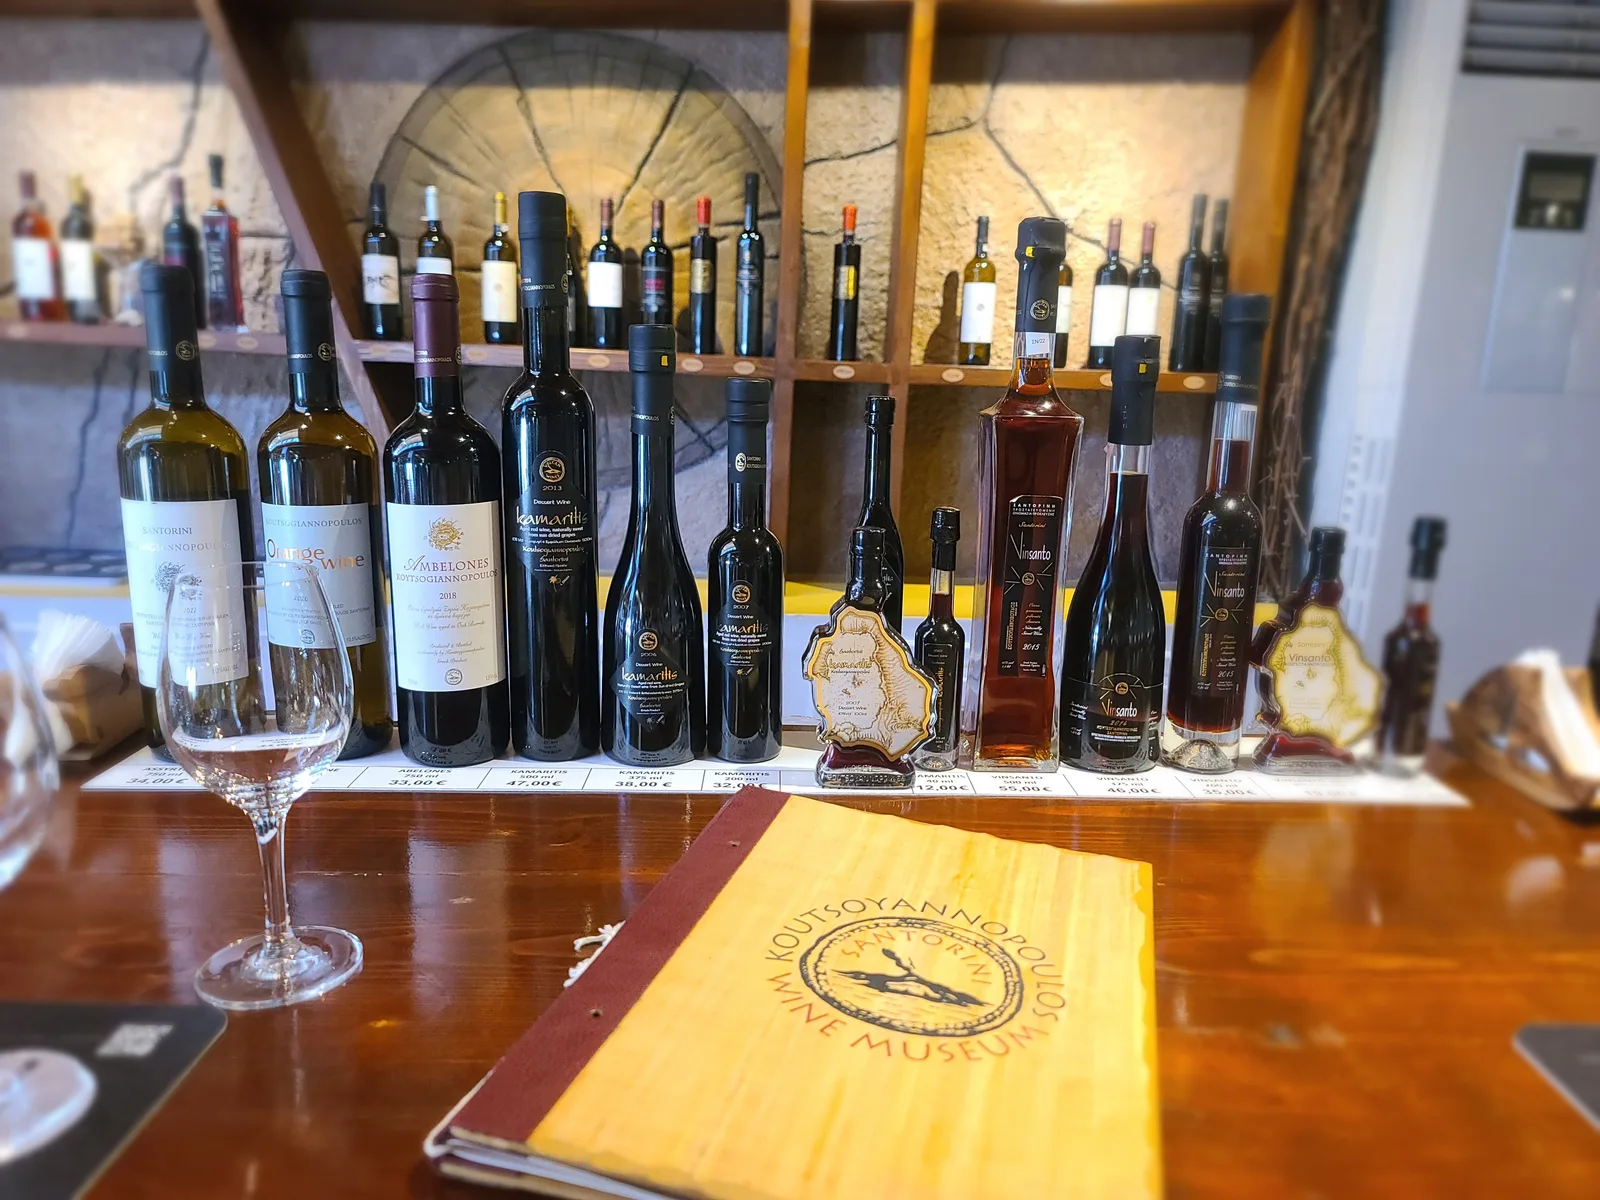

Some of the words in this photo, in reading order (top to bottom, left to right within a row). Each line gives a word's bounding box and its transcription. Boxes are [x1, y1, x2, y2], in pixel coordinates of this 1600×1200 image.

[516, 506, 588, 525] kamaritis
[142, 527, 193, 535] SANTORINI
[267, 538, 325, 565] Orange
[320, 555, 365, 570] wine
[1010, 531, 1051, 561] Vinsanto
[404, 555, 489, 572] AMBELONES
[1204, 571, 1245, 598] Vinsanto
[439, 592, 457, 600] 2018
[1022, 643, 1040, 651] 2015
[1289, 653, 1331, 662] Vinsanto
[621, 666, 678, 681] kamaritis
[1217, 670, 1235, 678] 2015
[1101, 698, 1138, 717] Vinsanto
[765, 897, 1066, 1022] KOUTSOYANNOPOULOS
[841, 930, 992, 985] SANTORINI
[767, 971, 847, 1037] WINE
[850, 1024, 1049, 1063] MUSEUM
